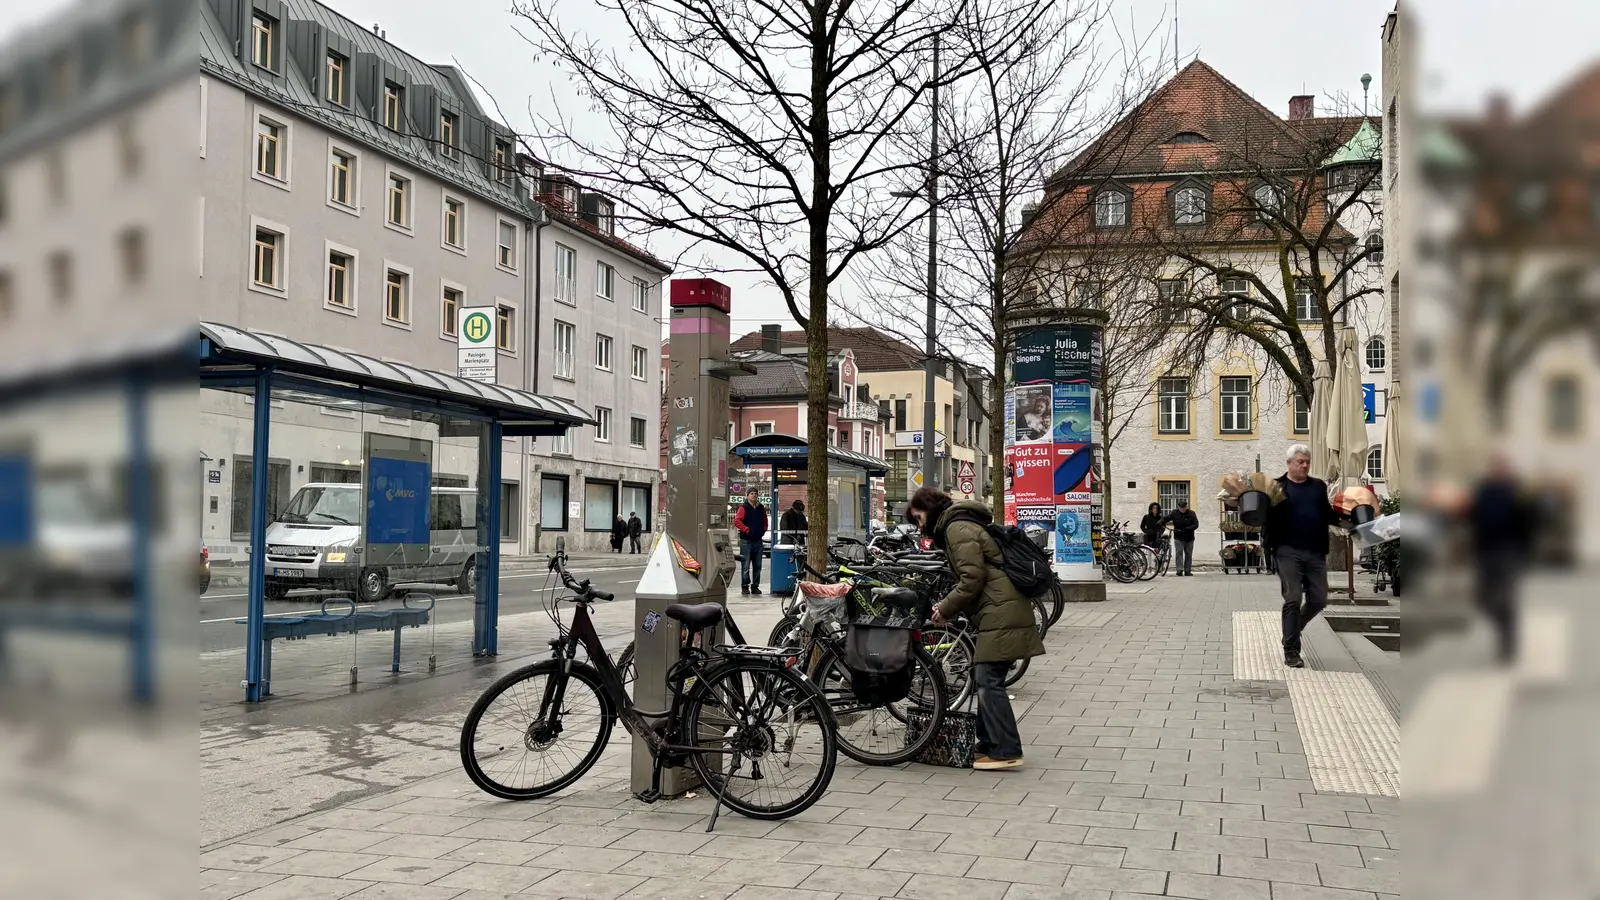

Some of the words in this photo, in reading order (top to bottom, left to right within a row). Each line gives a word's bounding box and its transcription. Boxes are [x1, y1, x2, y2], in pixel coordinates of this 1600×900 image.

[471, 318, 483, 336] H
[1054, 339, 1078, 349] Julia
[1054, 349, 1090, 360] Fischer
[1015, 448, 1032, 457] Gut
[1016, 458, 1050, 468] wissen
